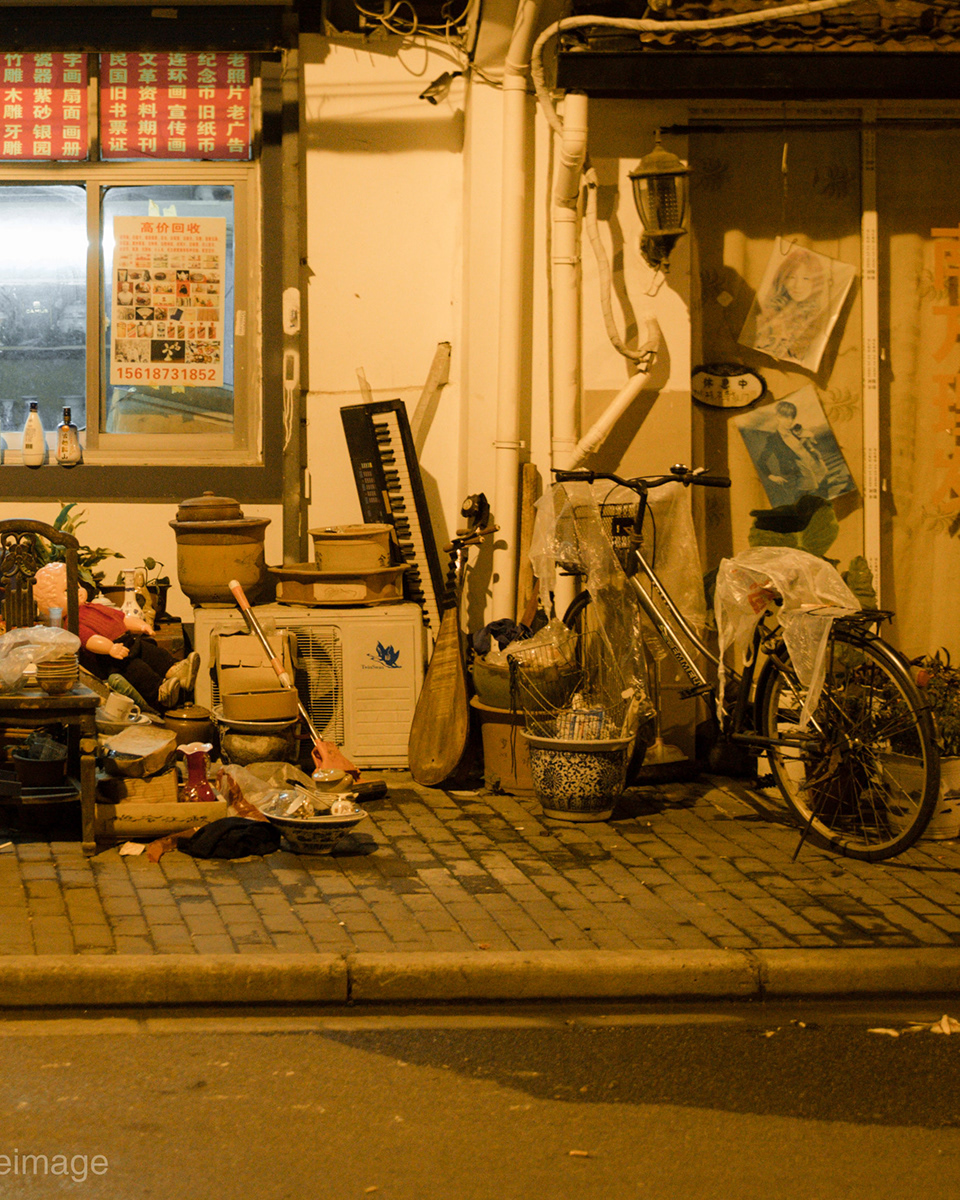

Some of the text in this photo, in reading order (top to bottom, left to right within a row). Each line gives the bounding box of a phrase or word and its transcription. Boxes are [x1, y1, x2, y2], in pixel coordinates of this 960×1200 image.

[3, 53, 23, 156] 竹雕木雕牙雕
[33, 53, 53, 156] 瓷器紫砂银园
[62, 53, 82, 157] 字画扇面画册
[108, 53, 128, 152] 民国旧书票证
[137, 53, 158, 152] 文革资料期刊
[167, 53, 188, 152] 连环画宣传画
[197, 53, 217, 152] 纪念币旧纸币
[226, 53, 247, 153] 老照片老广告
[141, 222, 200, 234] 高价回收
[117, 367, 216, 381] 15618731852
